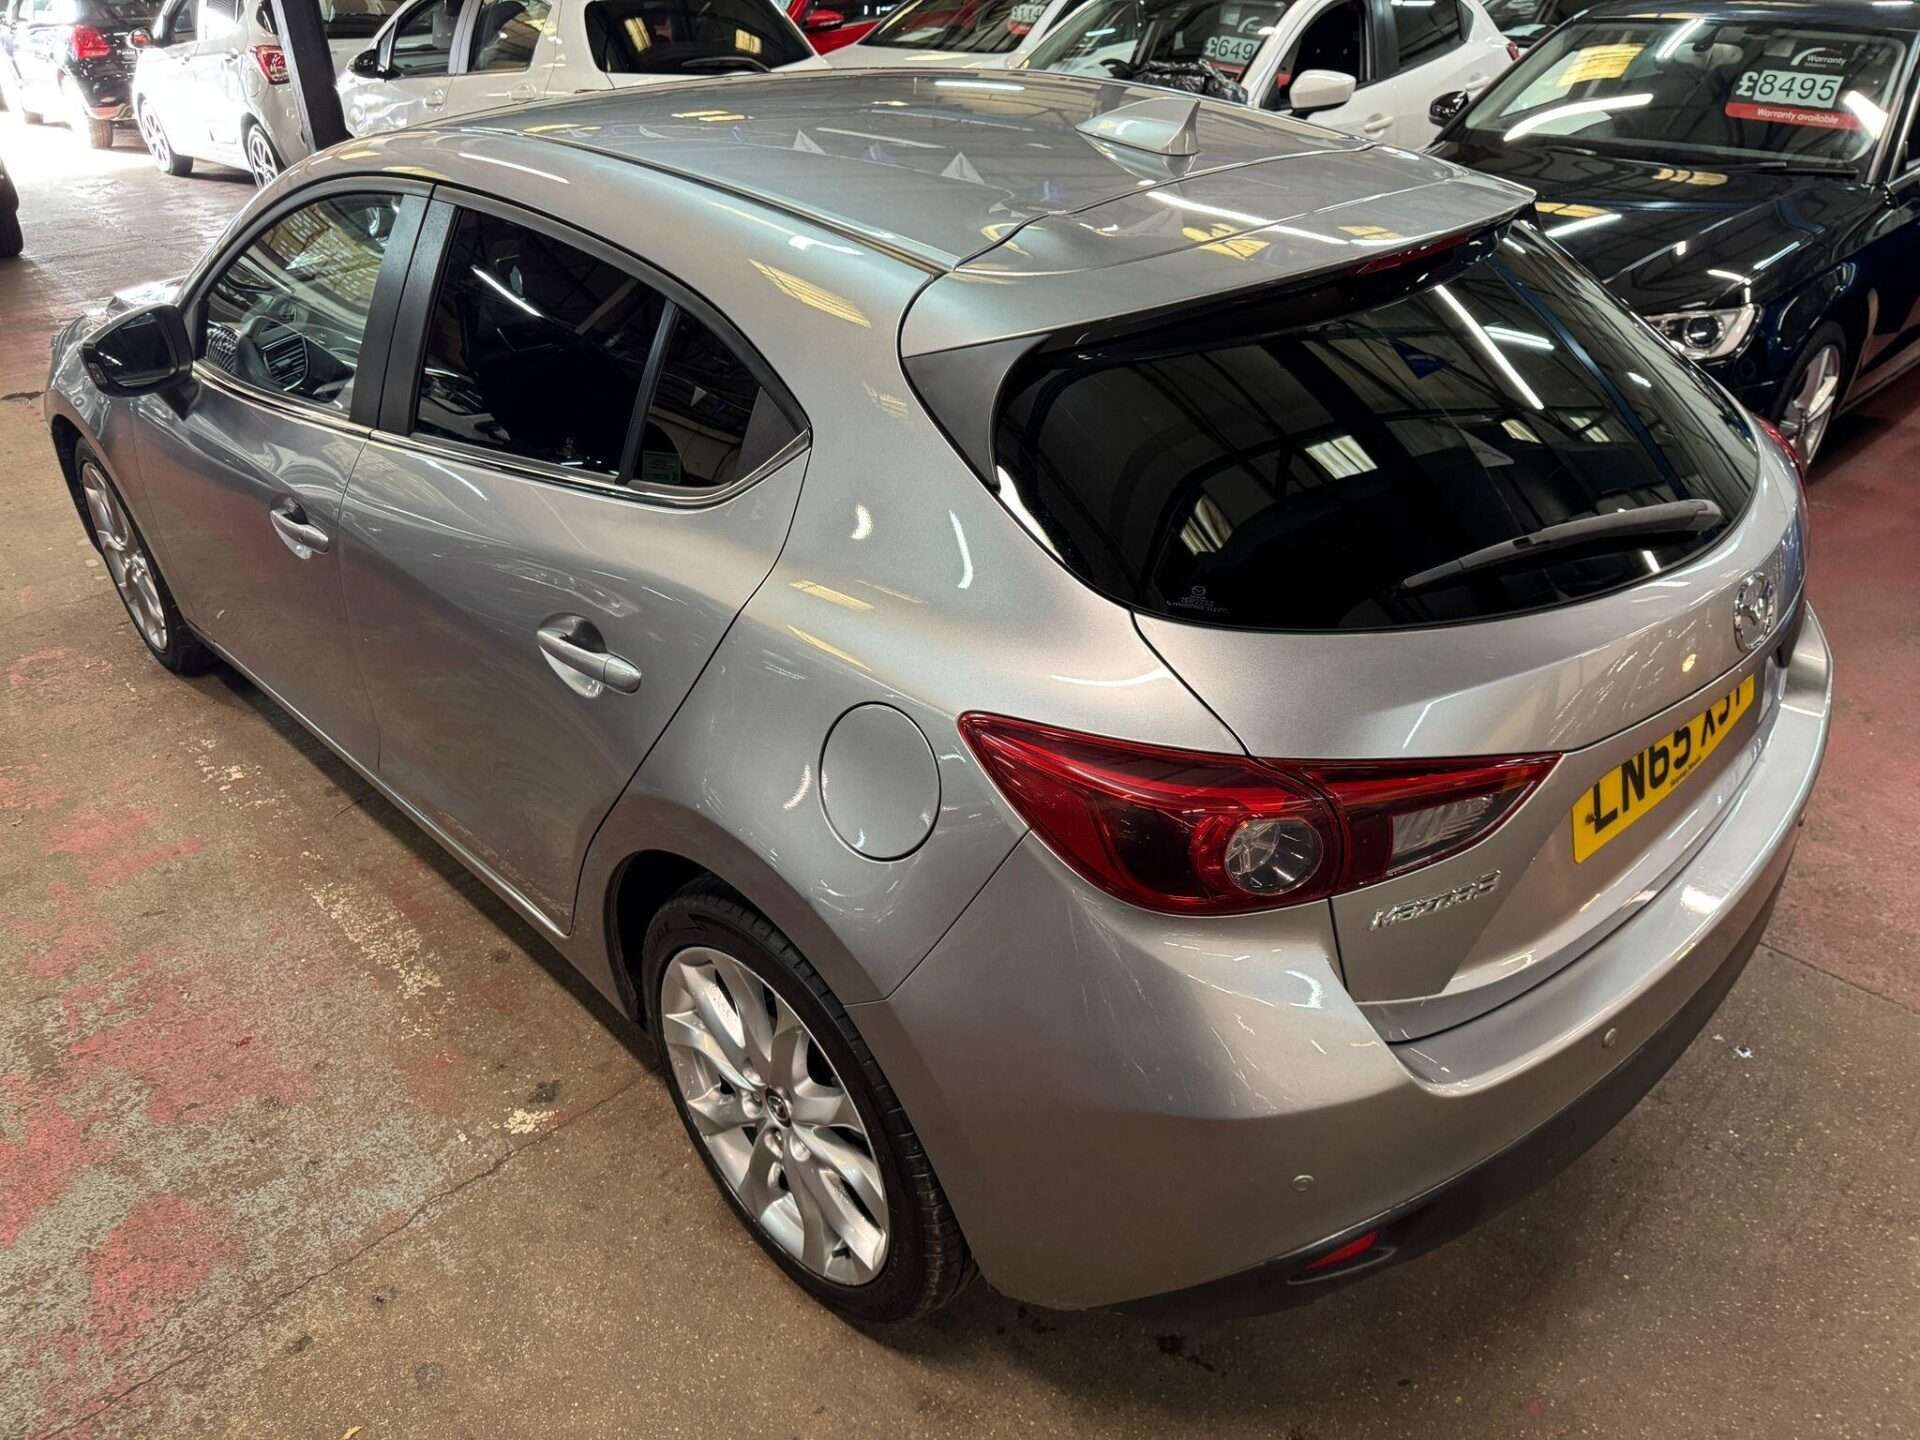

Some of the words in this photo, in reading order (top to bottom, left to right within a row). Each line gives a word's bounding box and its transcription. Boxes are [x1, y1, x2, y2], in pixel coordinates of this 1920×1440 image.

[1807, 54, 1848, 66] Warranty
[1736, 71, 1839, 101] £8495
[1757, 108, 1797, 121] Warranty
[1797, 112, 1839, 124] available
